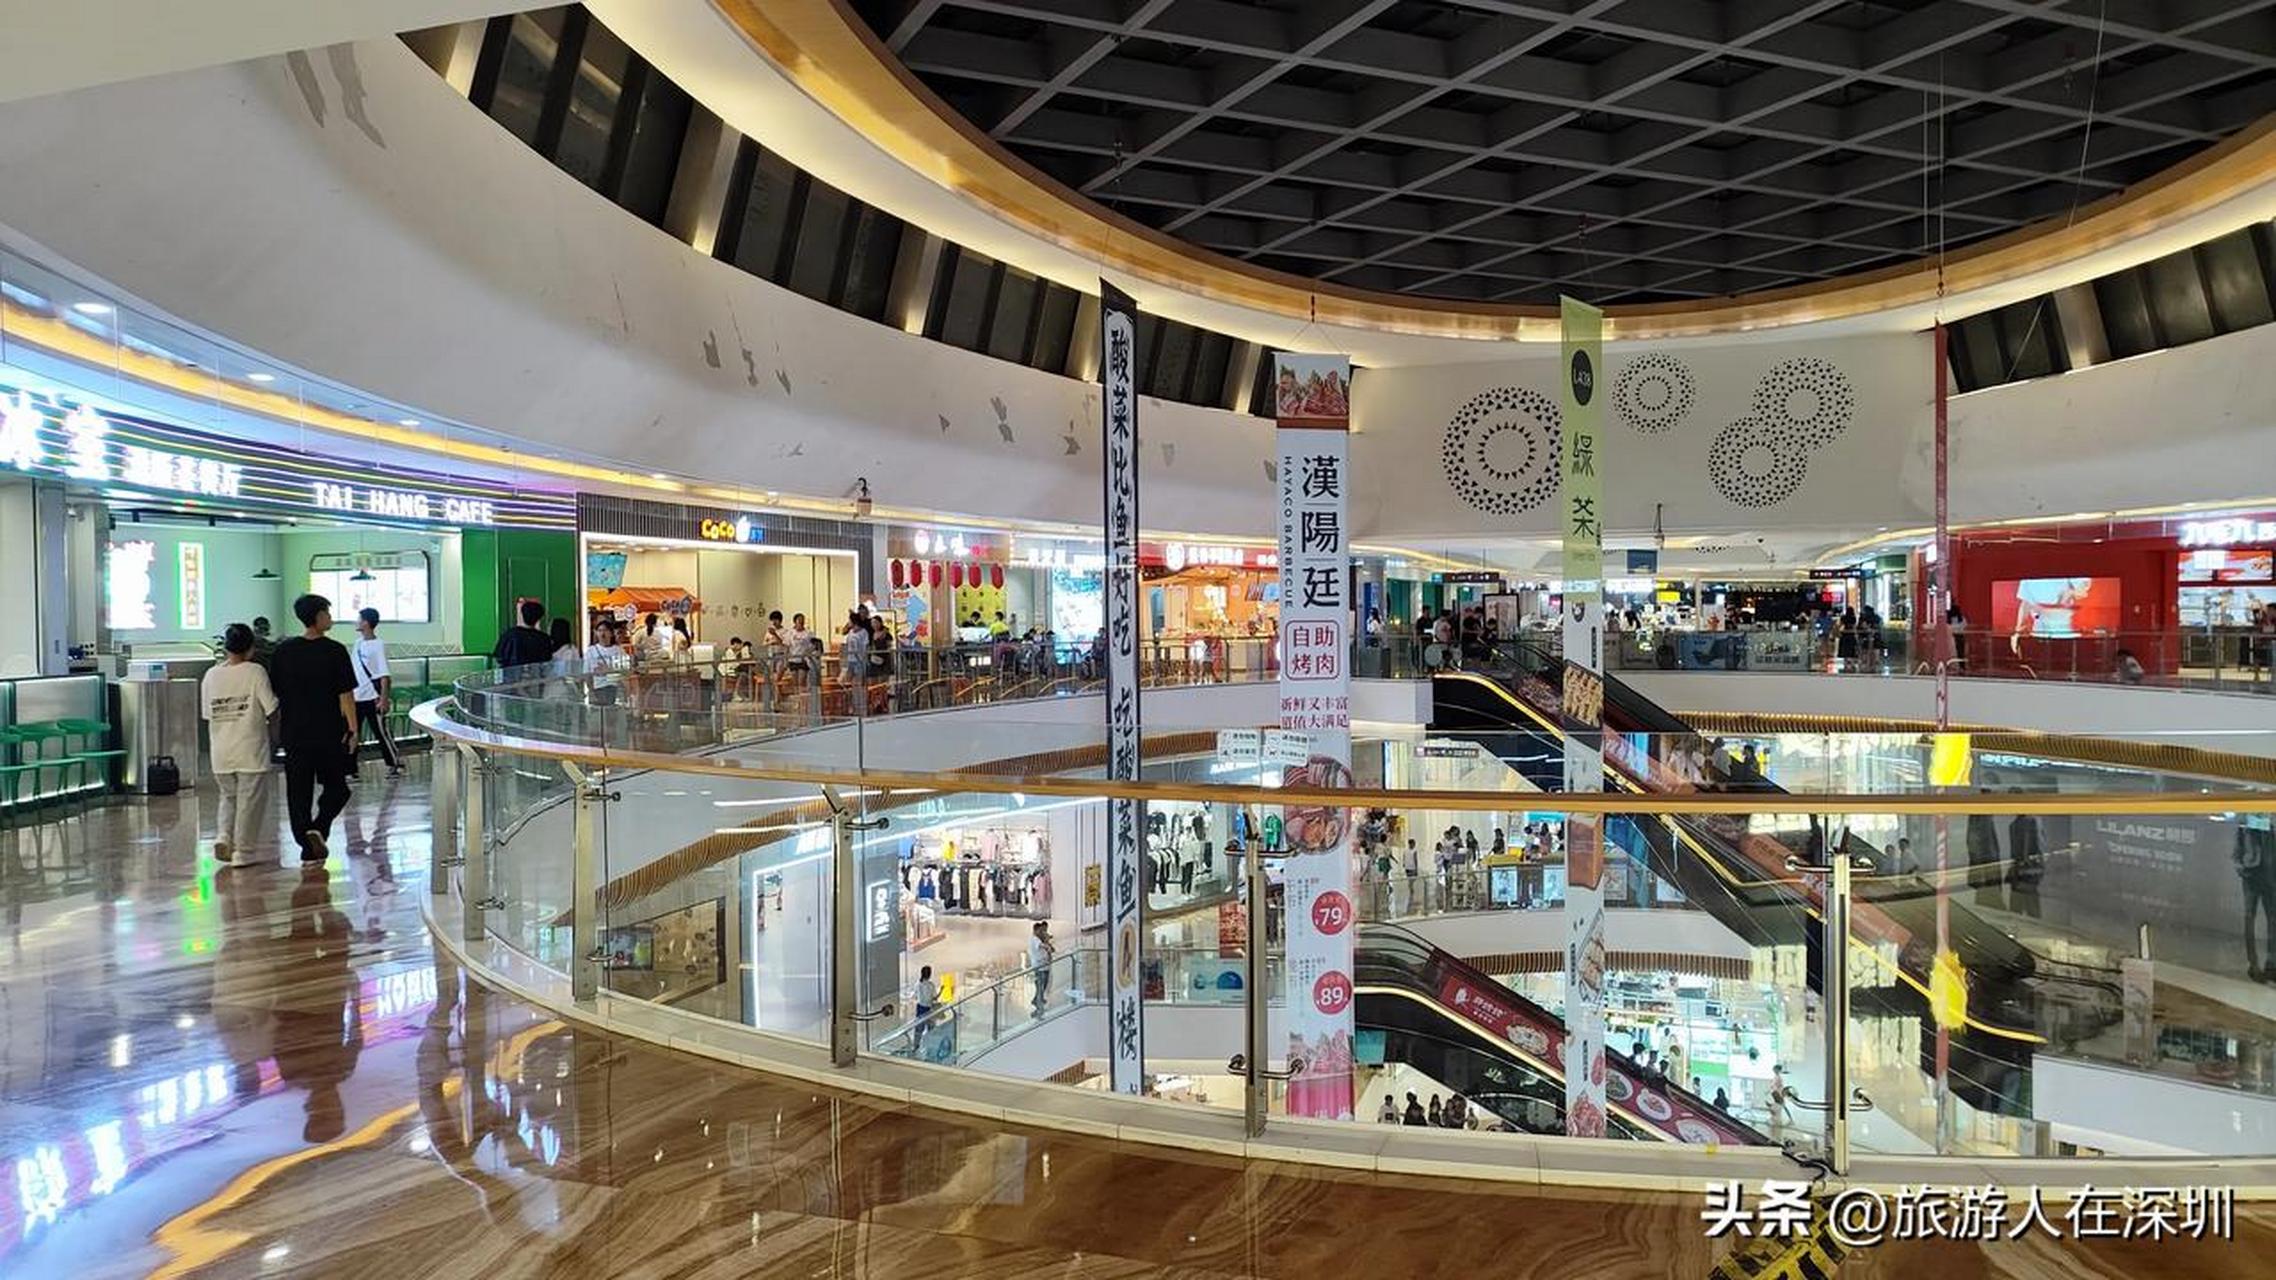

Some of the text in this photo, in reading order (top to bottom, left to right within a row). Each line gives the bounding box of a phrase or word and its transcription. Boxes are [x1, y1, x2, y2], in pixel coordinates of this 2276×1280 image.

[313, 482, 494, 525] TAI HANG CAFE
[701, 518, 736, 540] CoCo
[1284, 456, 1293, 609] HAYACO BARBECUE
[1301, 454, 1340, 608] 漢陽廷
[1293, 625, 1335, 648] 自助
[1292, 652, 1335, 675] 烤肉
